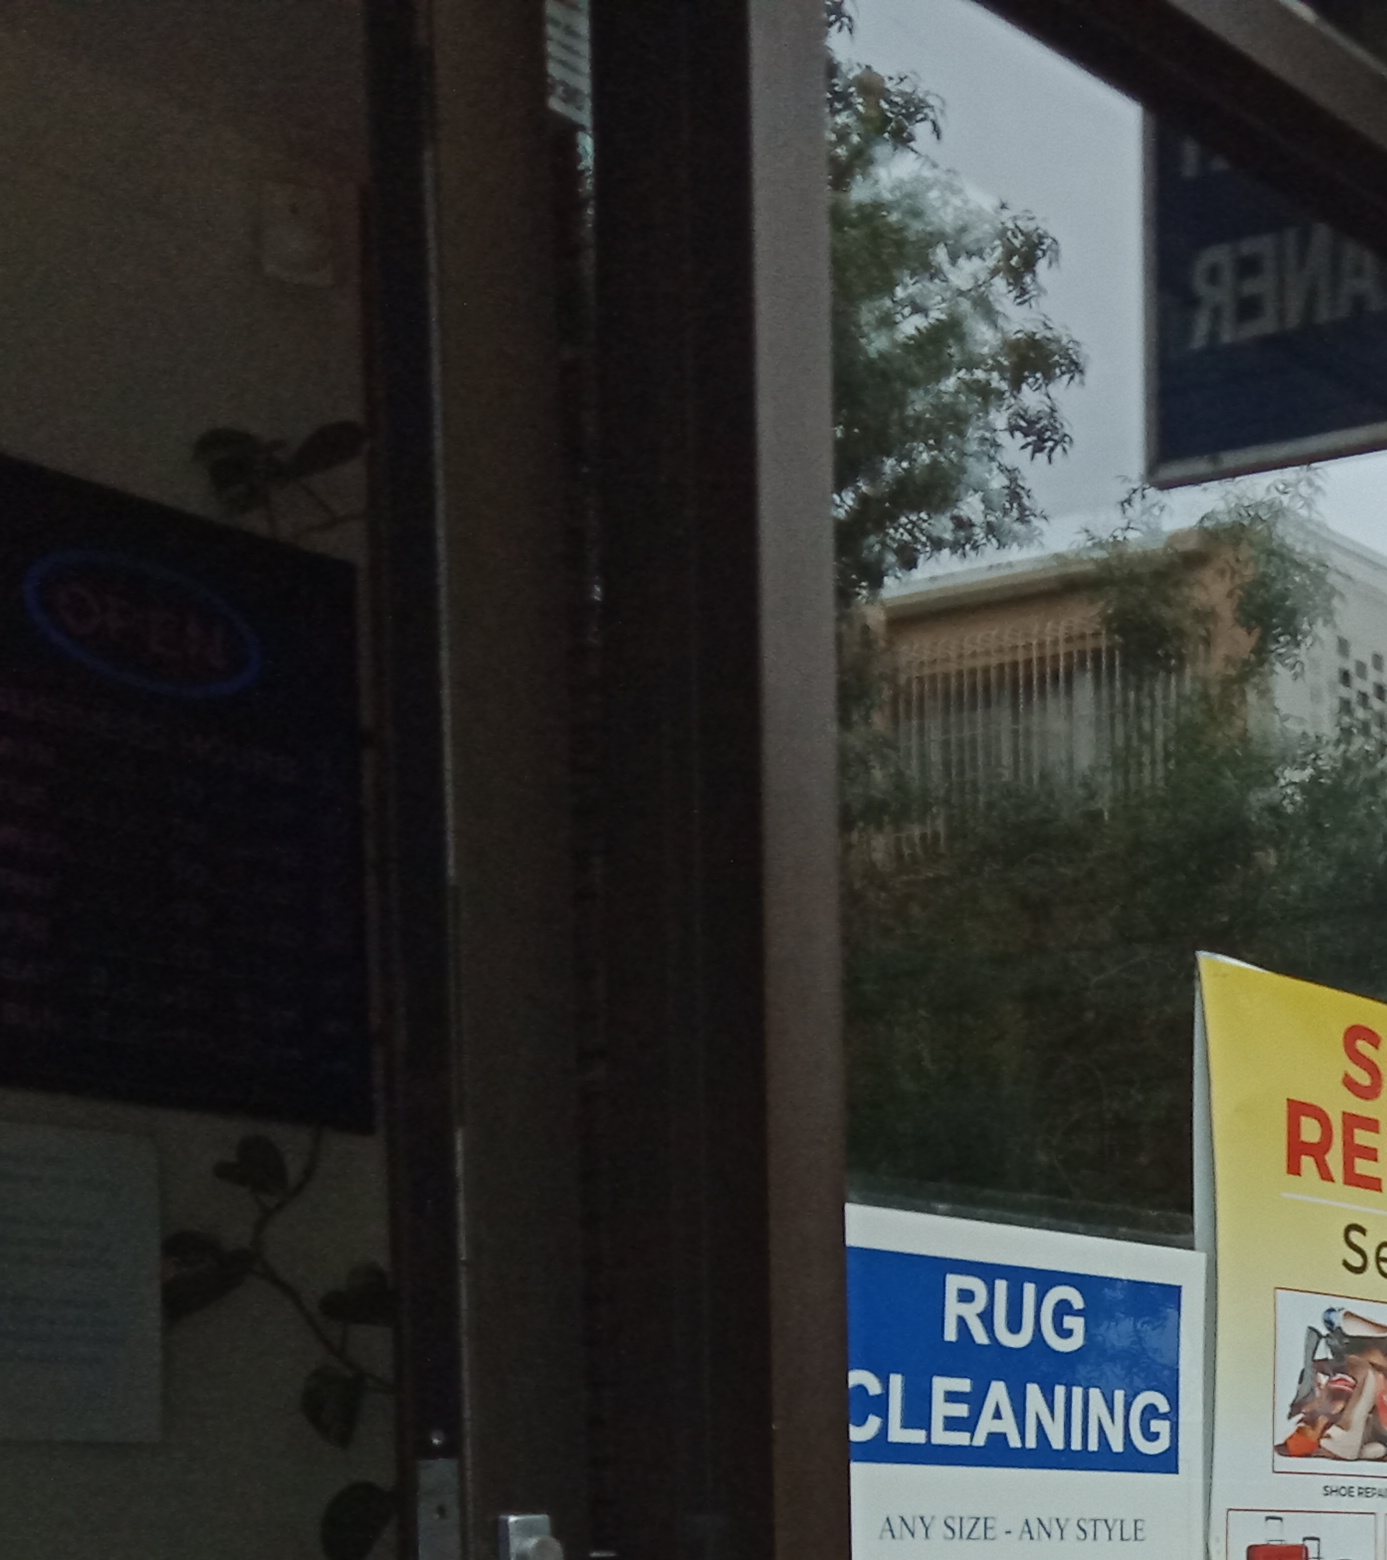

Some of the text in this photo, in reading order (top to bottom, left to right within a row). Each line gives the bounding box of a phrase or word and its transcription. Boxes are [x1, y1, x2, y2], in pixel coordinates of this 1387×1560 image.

[942, 1274, 1086, 1352] RUG
[847, 1370, 1172, 1456] CLEANING
[1322, 1485, 1356, 1499] SHOE
[879, 1515, 935, 1541] ANY
[943, 1515, 997, 1541] SIZE
[1018, 1517, 1072, 1542] ANY
[1076, 1518, 1146, 1542] STYLE
